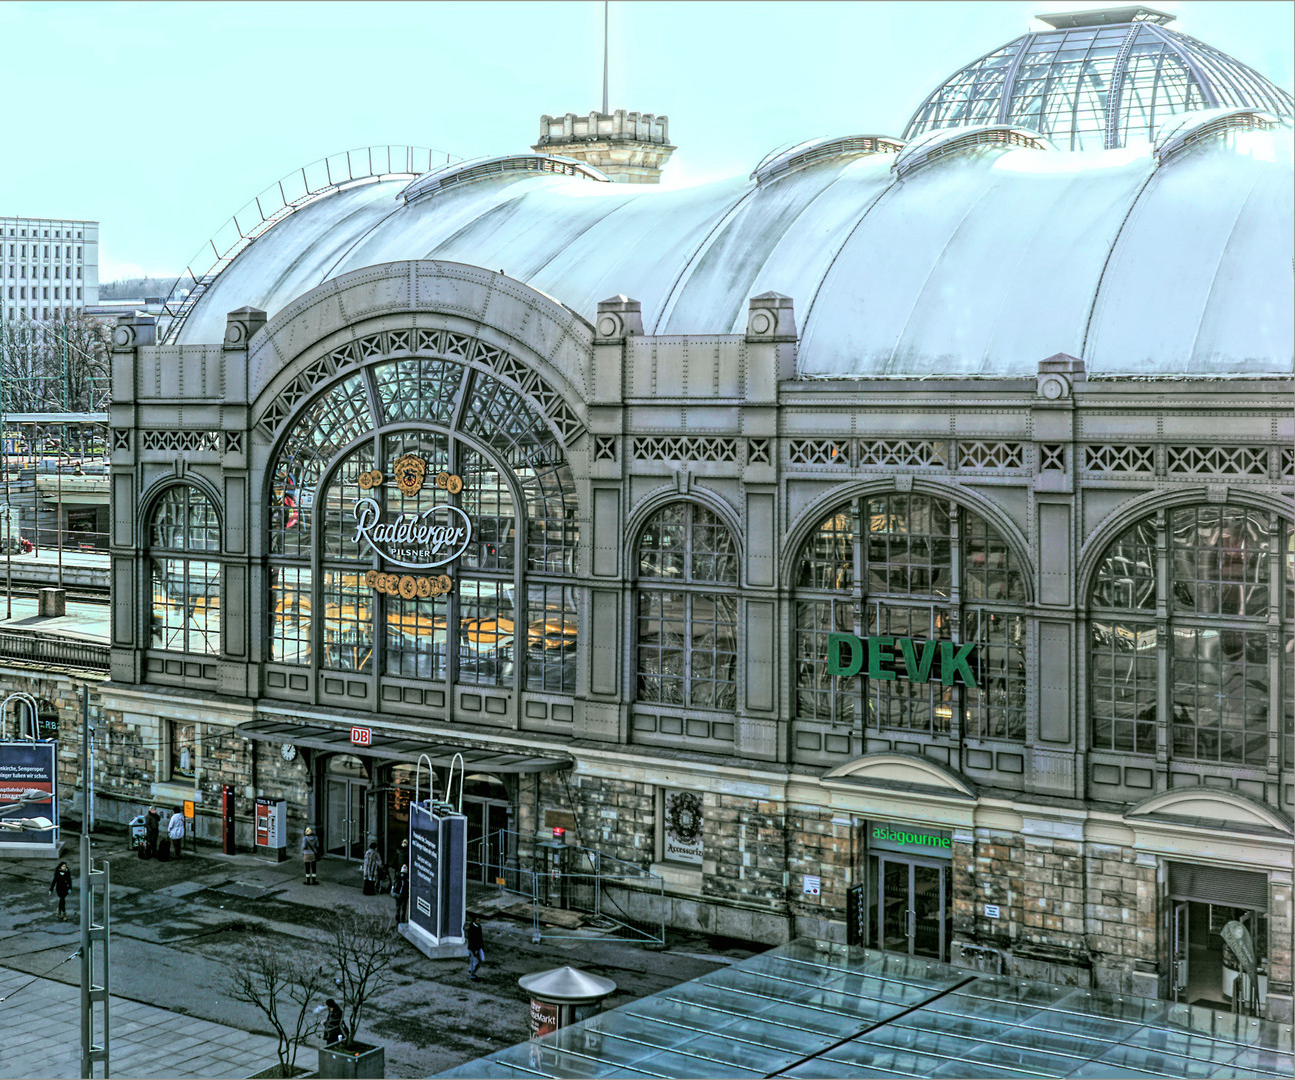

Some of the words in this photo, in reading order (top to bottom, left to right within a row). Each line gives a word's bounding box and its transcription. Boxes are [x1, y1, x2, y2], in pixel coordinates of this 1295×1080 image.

[351, 498, 472, 563] Radeberger
[391, 548, 431, 558] PILSNER
[828, 633, 977, 688] DEVK
[353, 730, 368, 742] DB
[872, 827, 953, 848] asiagourme
